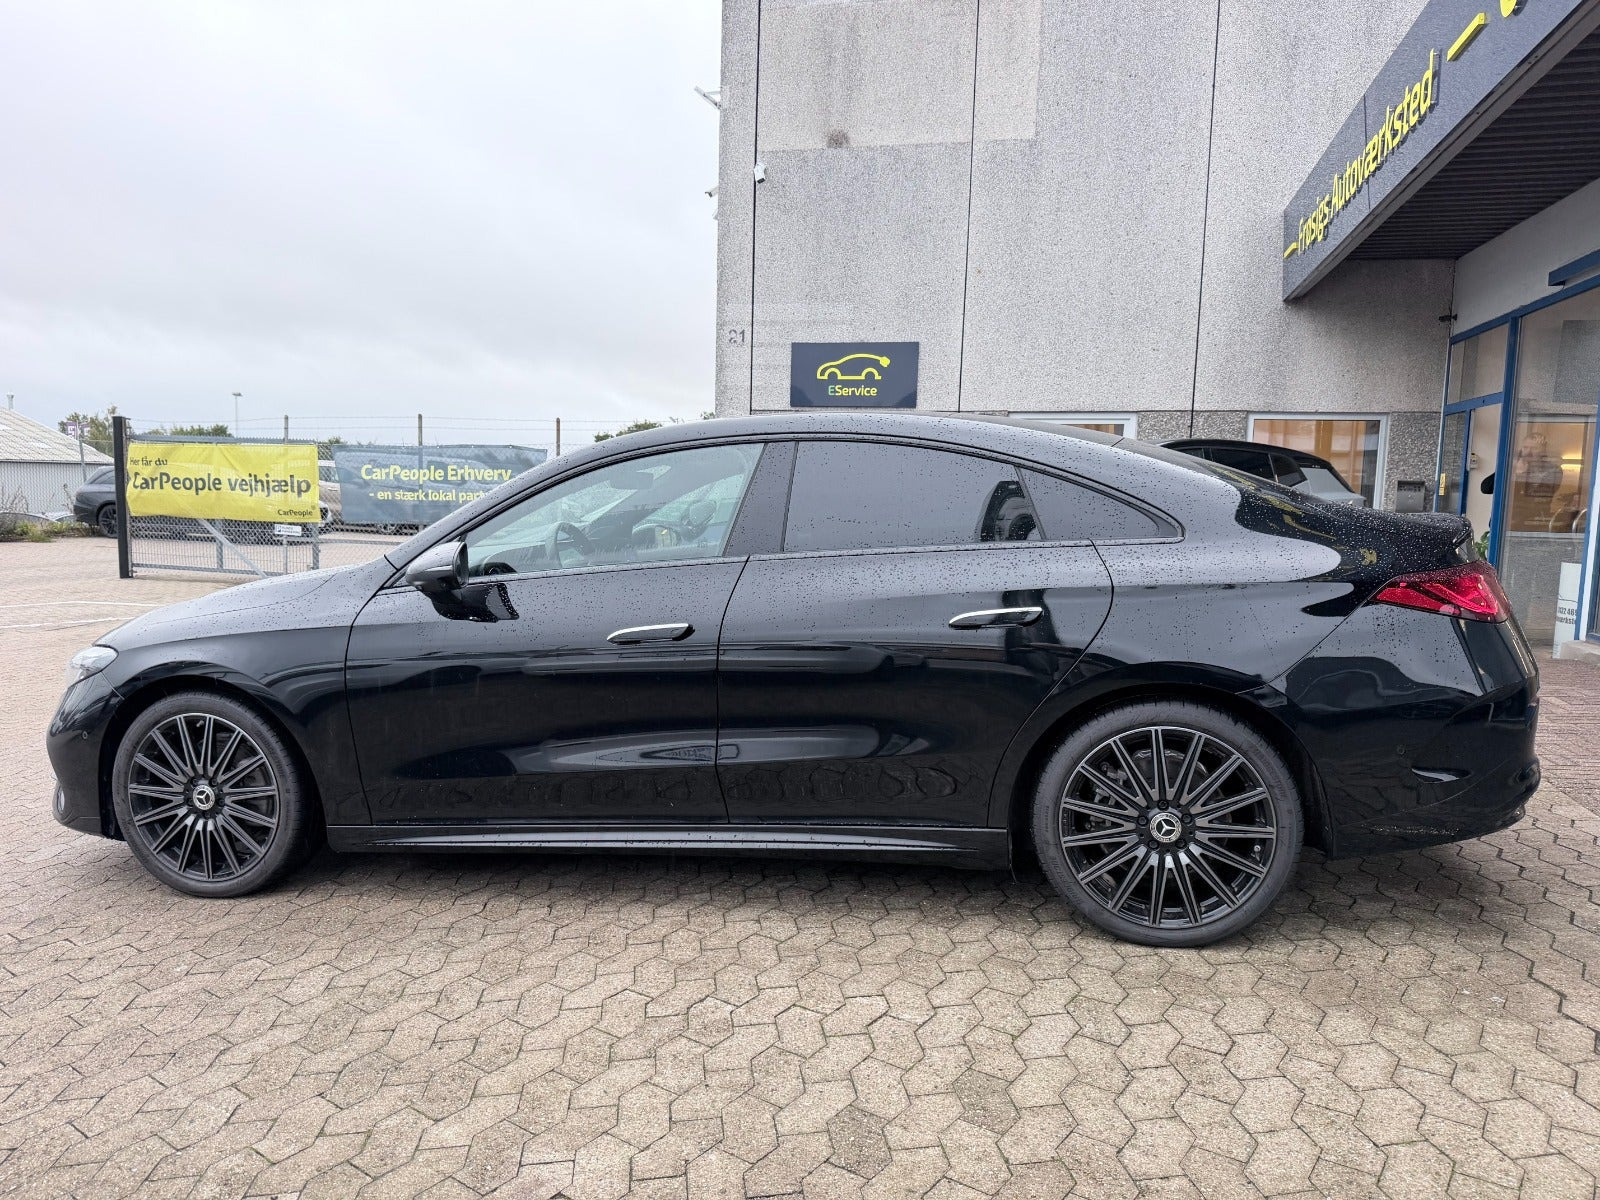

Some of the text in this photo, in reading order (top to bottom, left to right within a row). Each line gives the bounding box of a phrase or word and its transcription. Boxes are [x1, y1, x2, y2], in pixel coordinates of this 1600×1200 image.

[1331, 47, 1434, 219] Autoværksted
[728, 328, 746, 344] 21
[828, 385, 878, 396] EService
[129, 456, 168, 466] Her får du
[360, 464, 512, 483] CarPeople Erhverv
[132, 472, 311, 497] CarPeople vejhjælp
[377, 492, 392, 500] en
[394, 490, 426, 501] stærk
[428, 490, 456, 501] lokal
[459, 491, 485, 503] part
[277, 509, 313, 517] CarPeople
